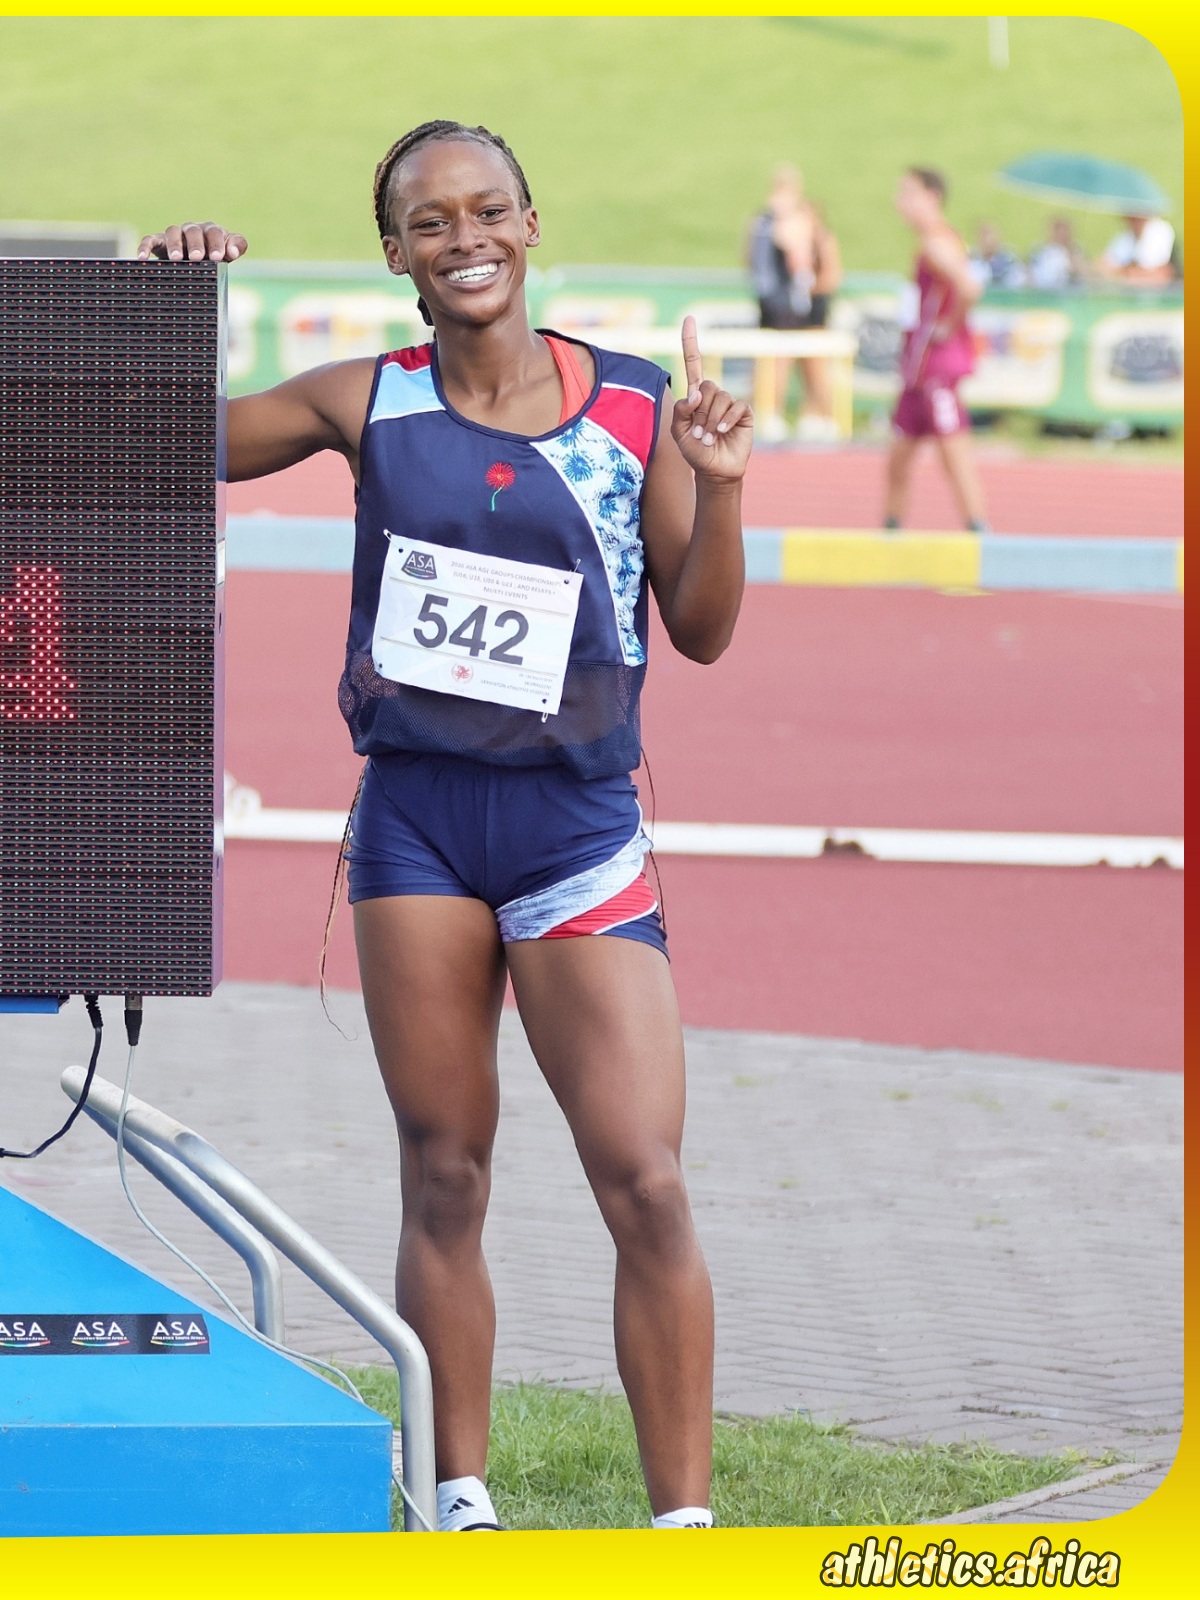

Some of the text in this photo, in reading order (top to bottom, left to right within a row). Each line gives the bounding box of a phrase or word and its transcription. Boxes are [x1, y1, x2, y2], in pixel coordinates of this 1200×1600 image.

[408, 553, 435, 570] ASA
[413, 593, 530, 666] 542
[74, 1321, 125, 1337] ASA
[153, 1321, 204, 1336] ASA
